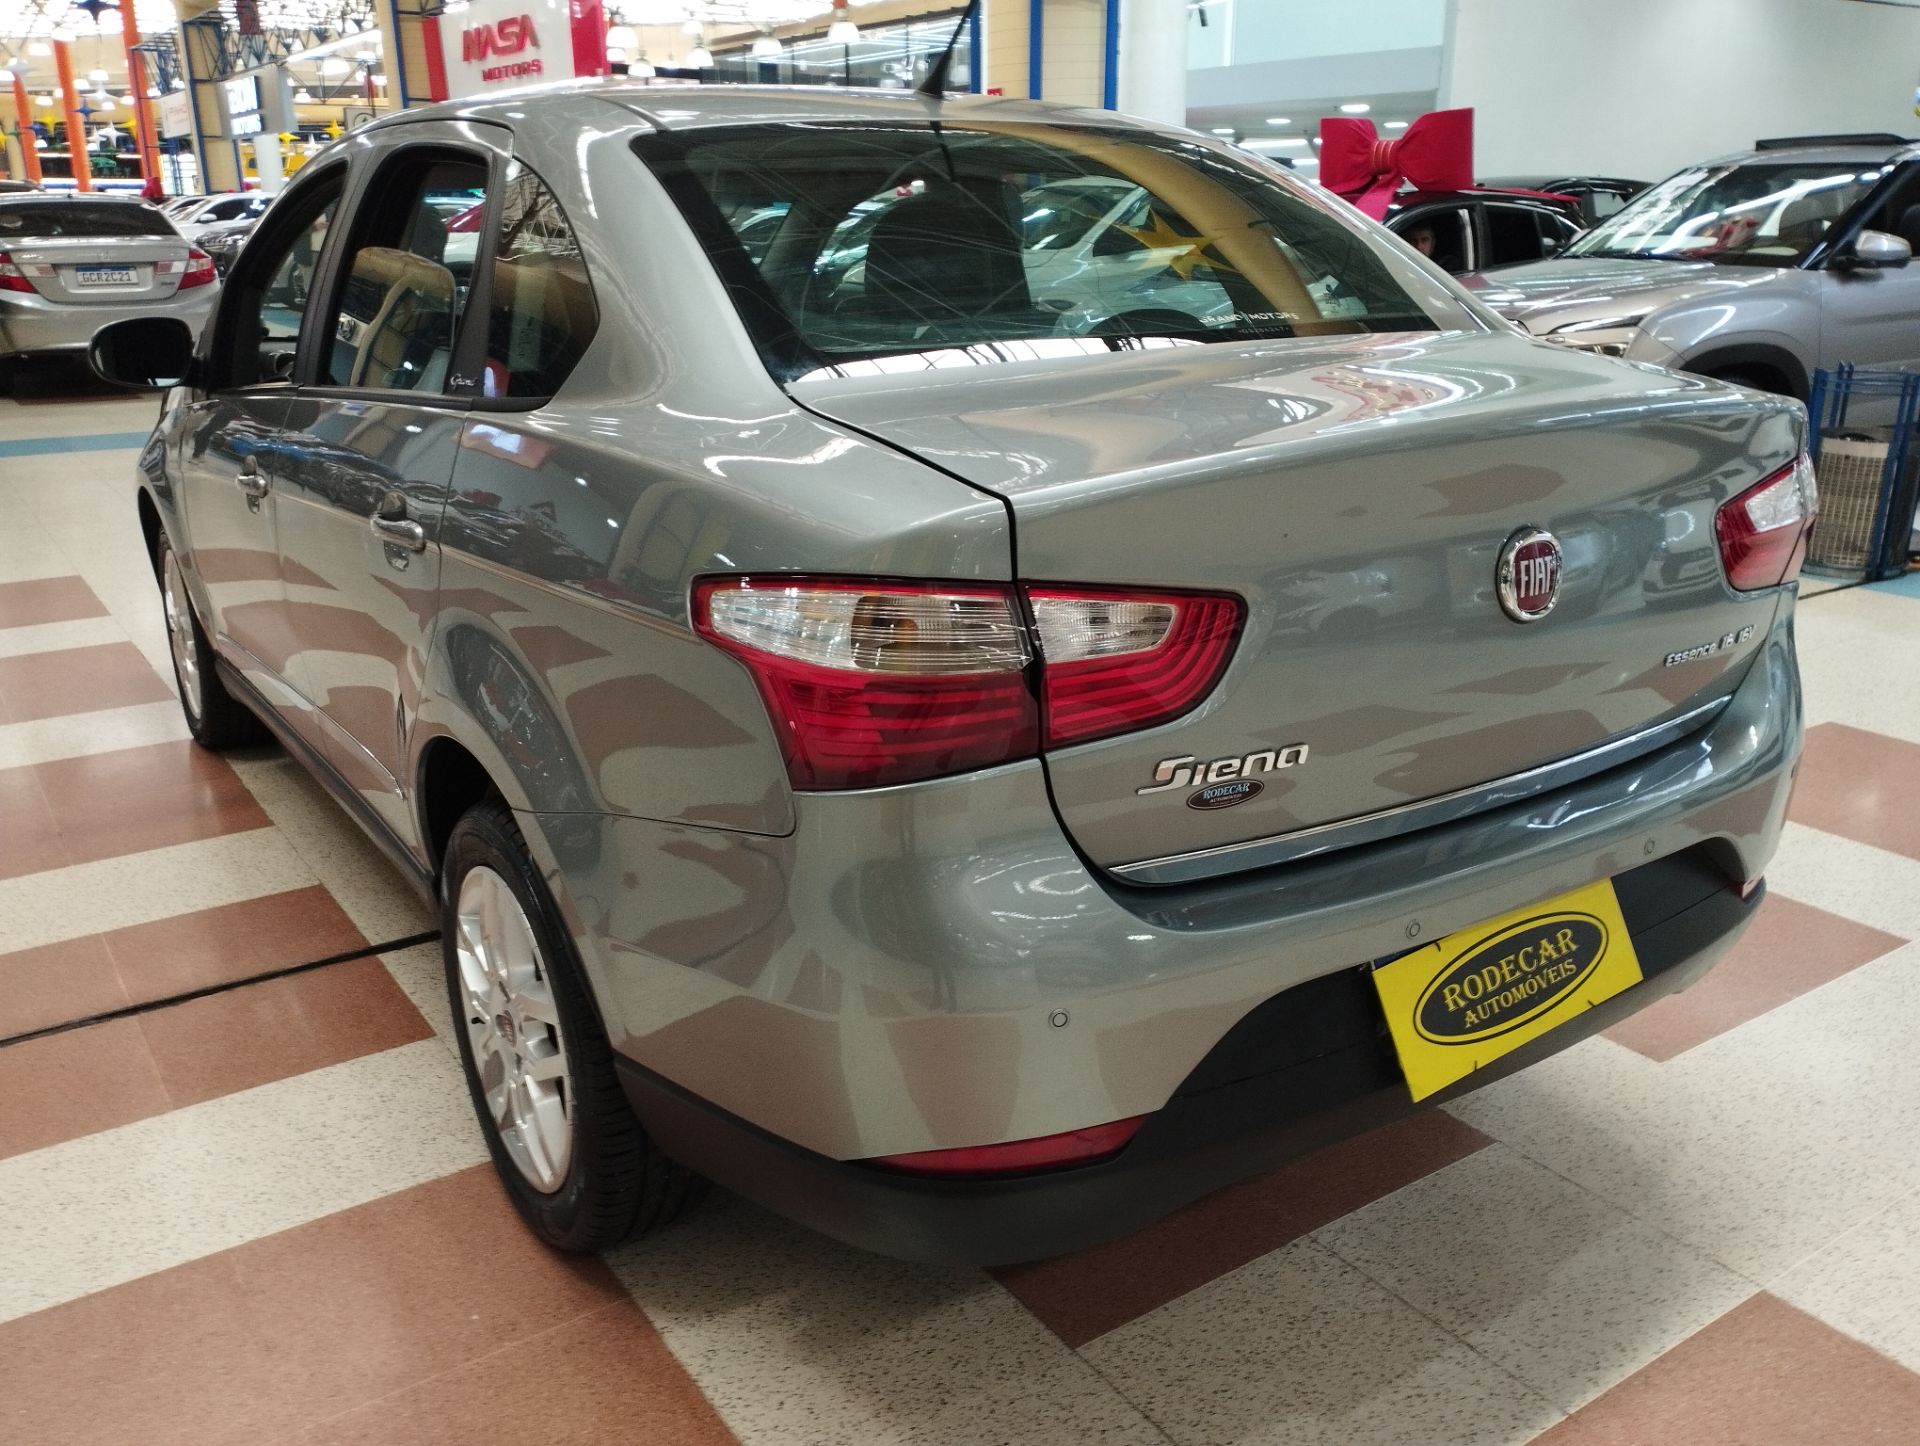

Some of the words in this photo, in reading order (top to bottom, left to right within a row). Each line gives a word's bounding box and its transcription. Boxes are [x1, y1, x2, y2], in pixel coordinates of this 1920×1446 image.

[462, 14, 541, 62] NASA
[482, 58, 543, 82] MOTORS
[82, 271, 133, 283] GCR2C21
[1519, 555, 1556, 599] FIAT
[1664, 642, 1716, 668] Essence
[1136, 742, 1310, 796] Siena
[1203, 782, 1251, 800] RODECAR
[1441, 928, 1580, 1013] RODECAR
[1463, 958, 1578, 1029] AUTOMÓVEIS
